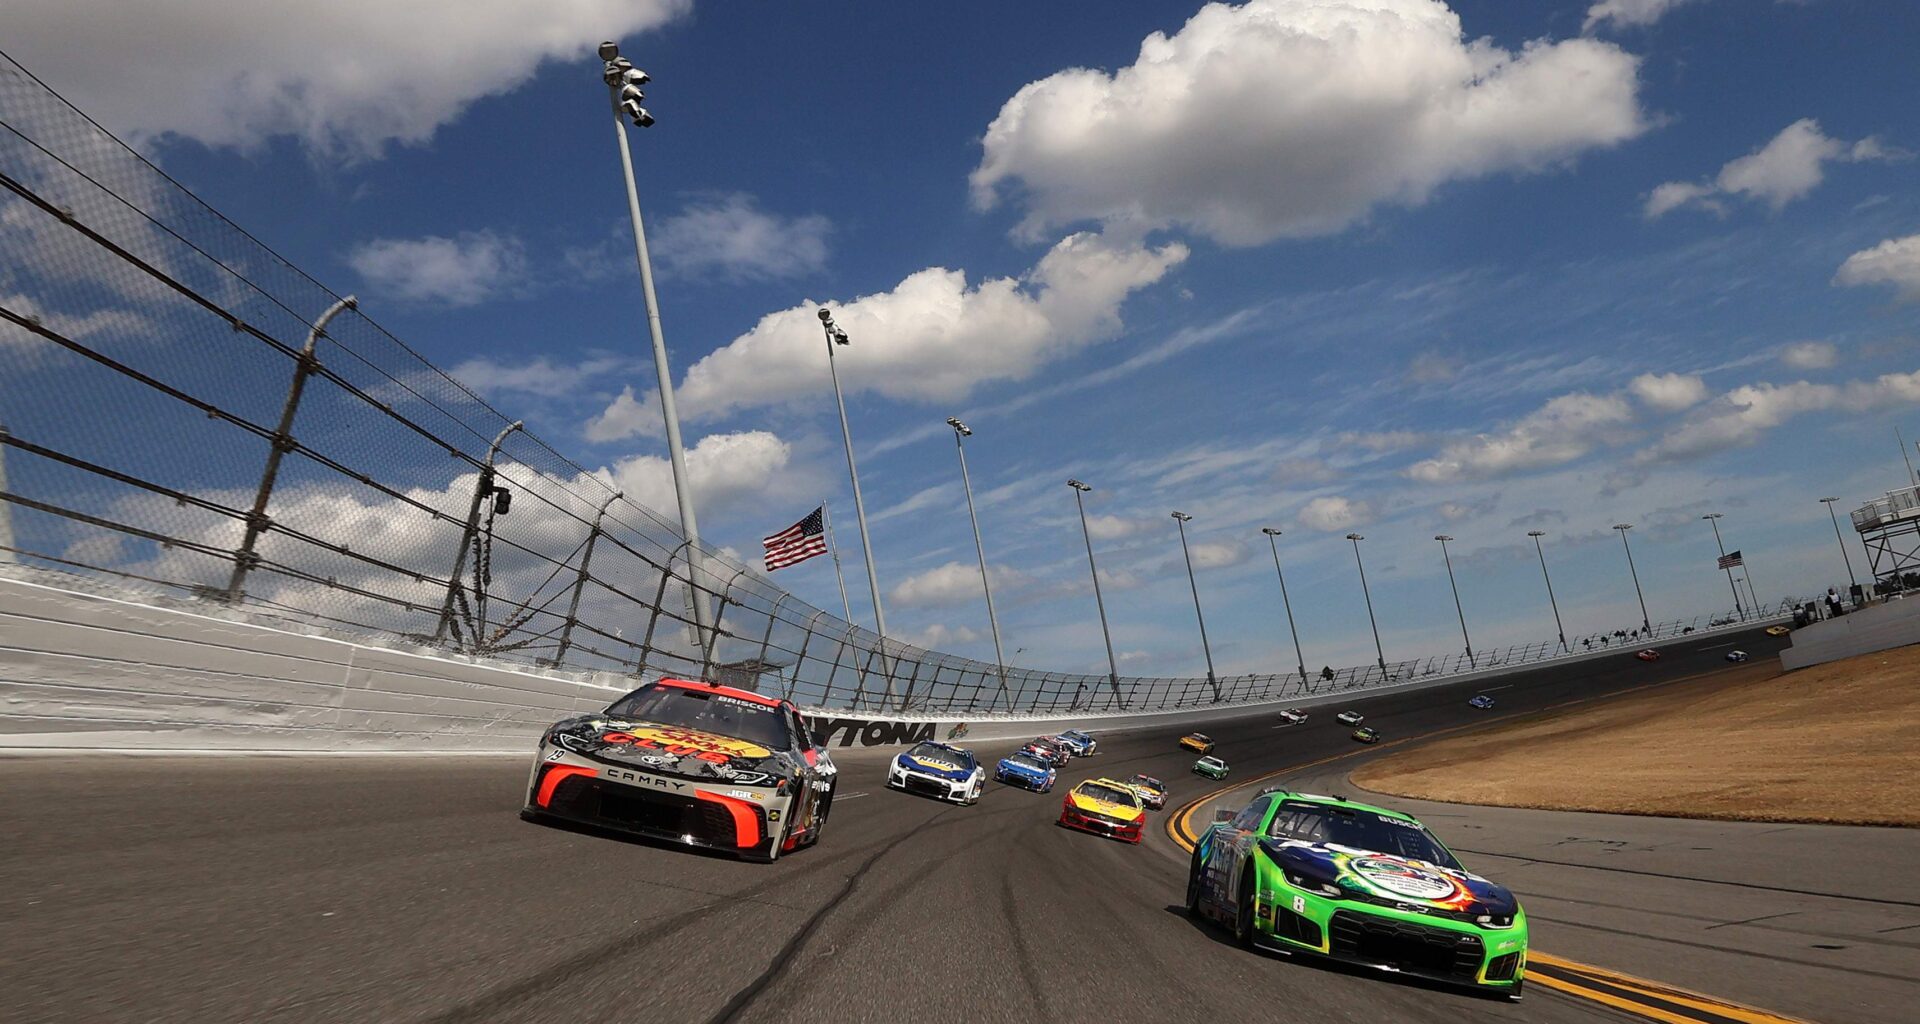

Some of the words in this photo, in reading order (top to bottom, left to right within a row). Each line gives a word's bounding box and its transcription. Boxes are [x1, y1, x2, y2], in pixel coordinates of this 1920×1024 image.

[717, 695, 775, 714] BRISCOE
[545, 749, 566, 761] 19
[602, 731, 731, 764] CLUB
[918, 756, 955, 769] NAPA
[606, 768, 686, 790] CAMRY
[1292, 895, 1305, 913] 8
